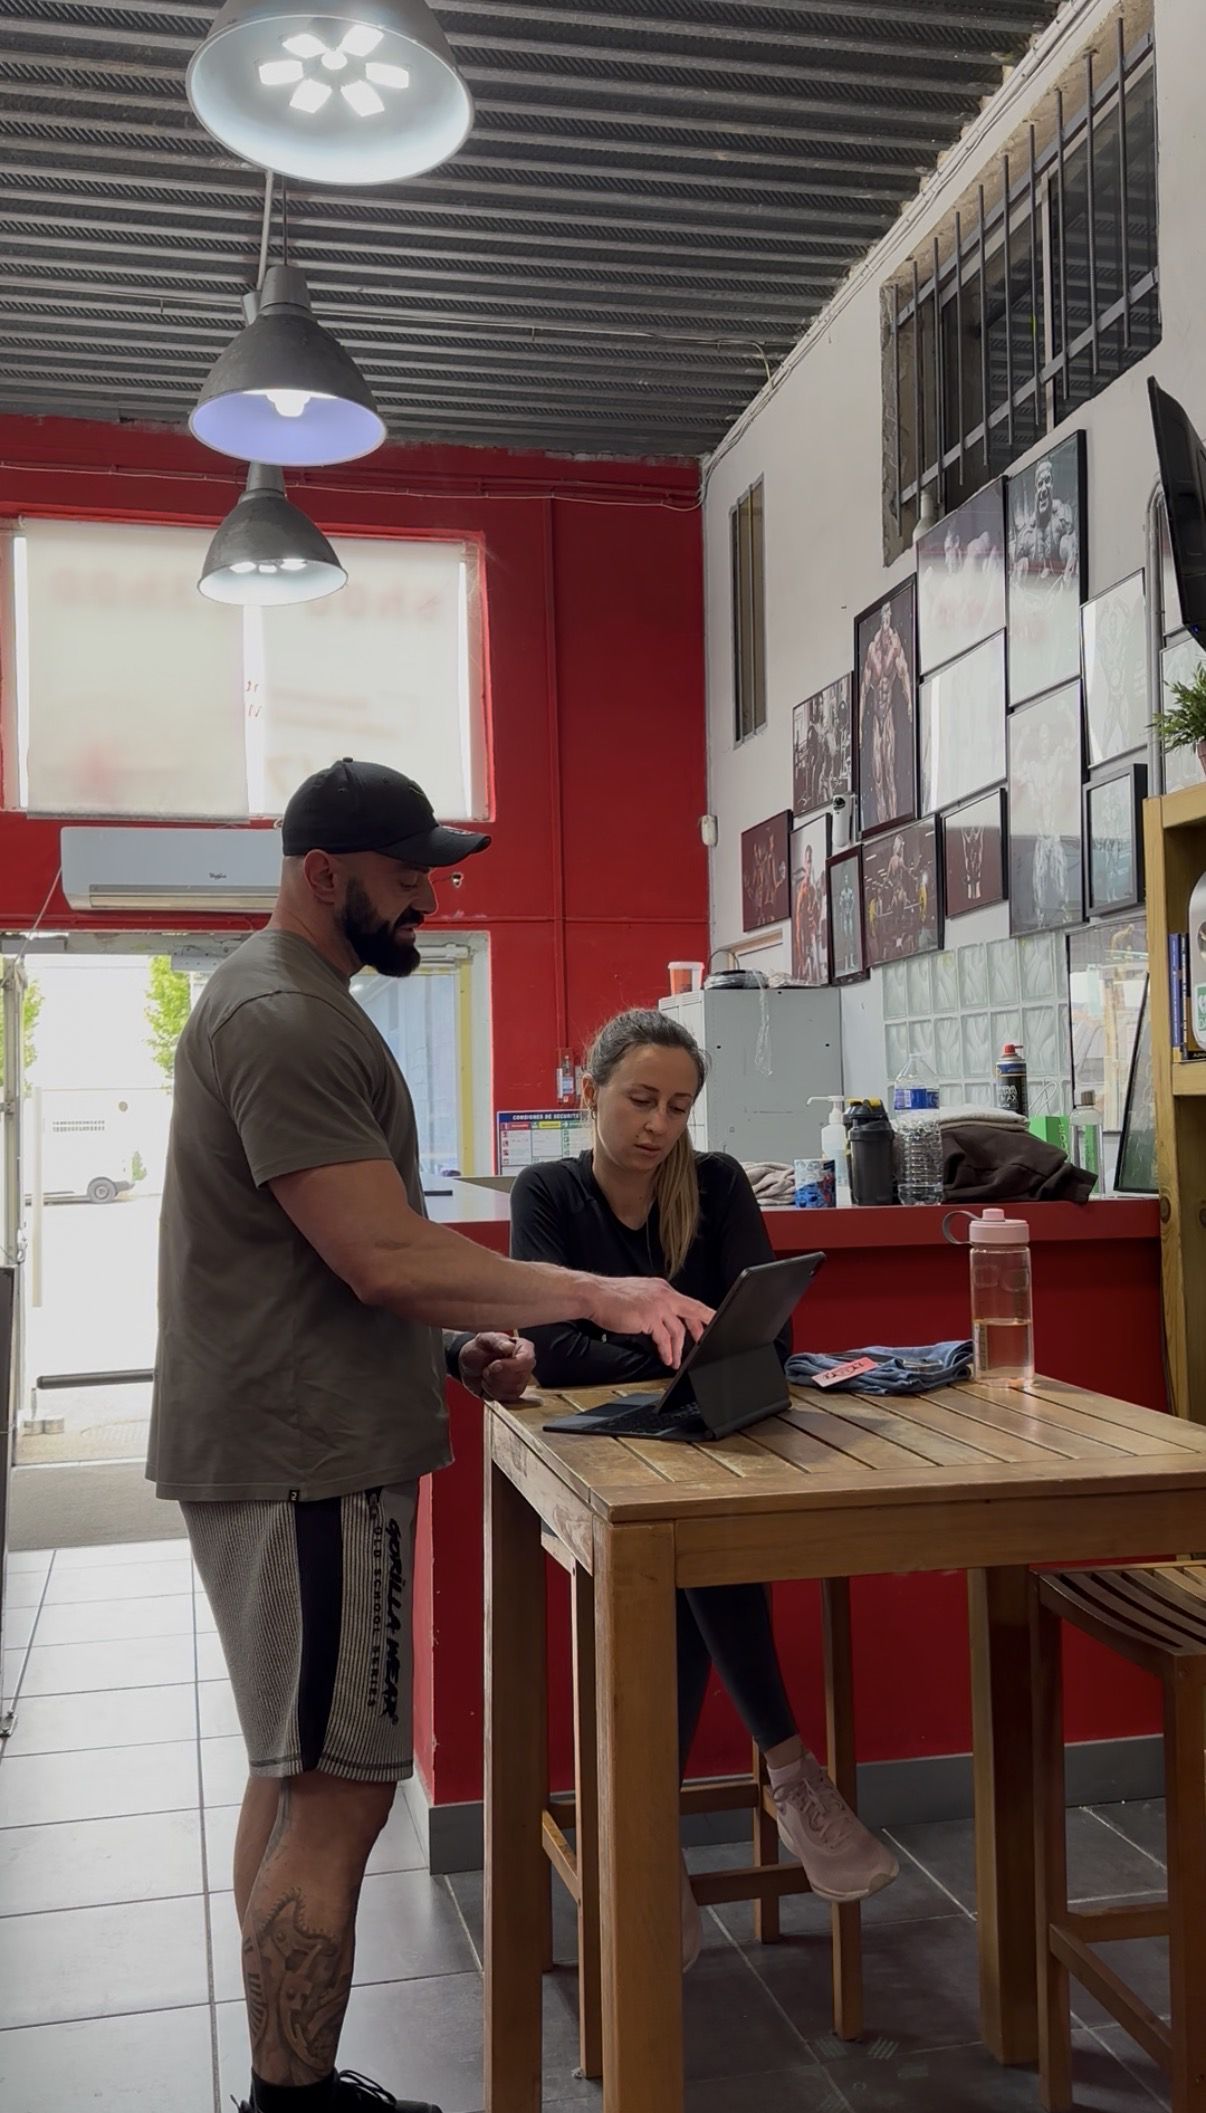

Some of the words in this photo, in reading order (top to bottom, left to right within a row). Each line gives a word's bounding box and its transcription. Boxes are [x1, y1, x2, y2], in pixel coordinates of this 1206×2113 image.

[373, 1526, 382, 1558] OLD
[372, 1567, 382, 1634] SCHOOL
[385, 1518, 406, 1635] GORILLA
[368, 1644, 381, 1707] SERIES
[380, 1636, 401, 1719] WEAR
